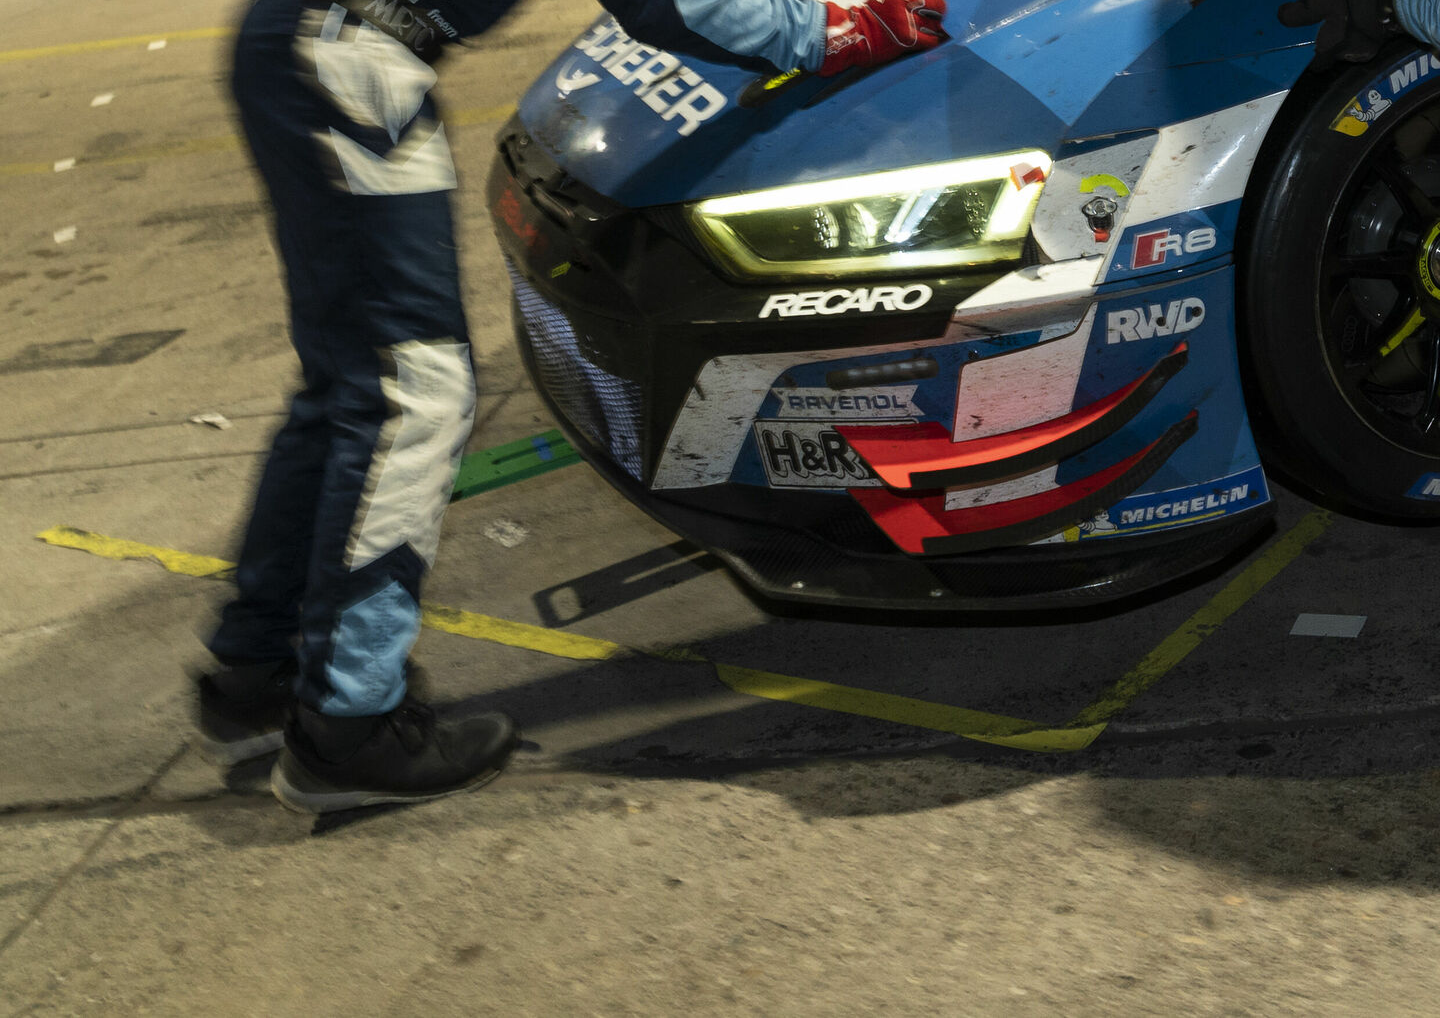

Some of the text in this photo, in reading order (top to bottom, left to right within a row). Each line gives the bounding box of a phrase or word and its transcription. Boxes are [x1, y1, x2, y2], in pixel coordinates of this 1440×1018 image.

[1150, 227, 1217, 262] R8
[758, 283, 934, 319] RECARO
[1106, 296, 1206, 345] RWD
[788, 393, 908, 412] RAVENOL
[1120, 483, 1249, 525] MICHELIN
